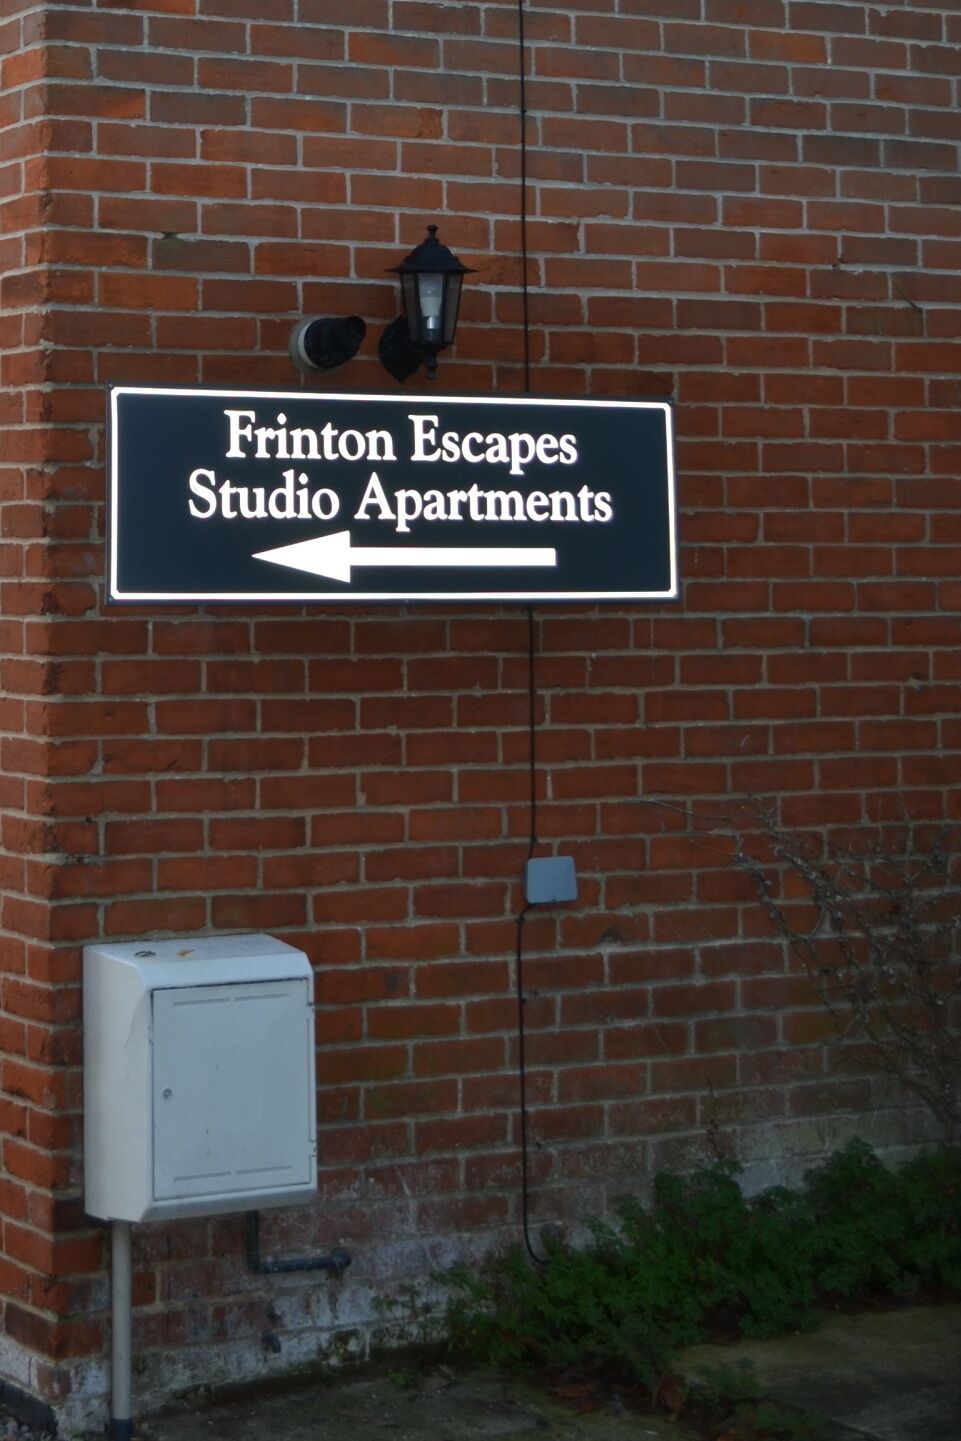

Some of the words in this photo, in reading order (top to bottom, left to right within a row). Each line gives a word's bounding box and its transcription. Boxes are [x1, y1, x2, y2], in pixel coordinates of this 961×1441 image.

[223, 409, 398, 463] Frinton
[407, 413, 579, 476] Escapes
[187, 468, 341, 522] Studio
[353, 471, 614, 533] Apartments
